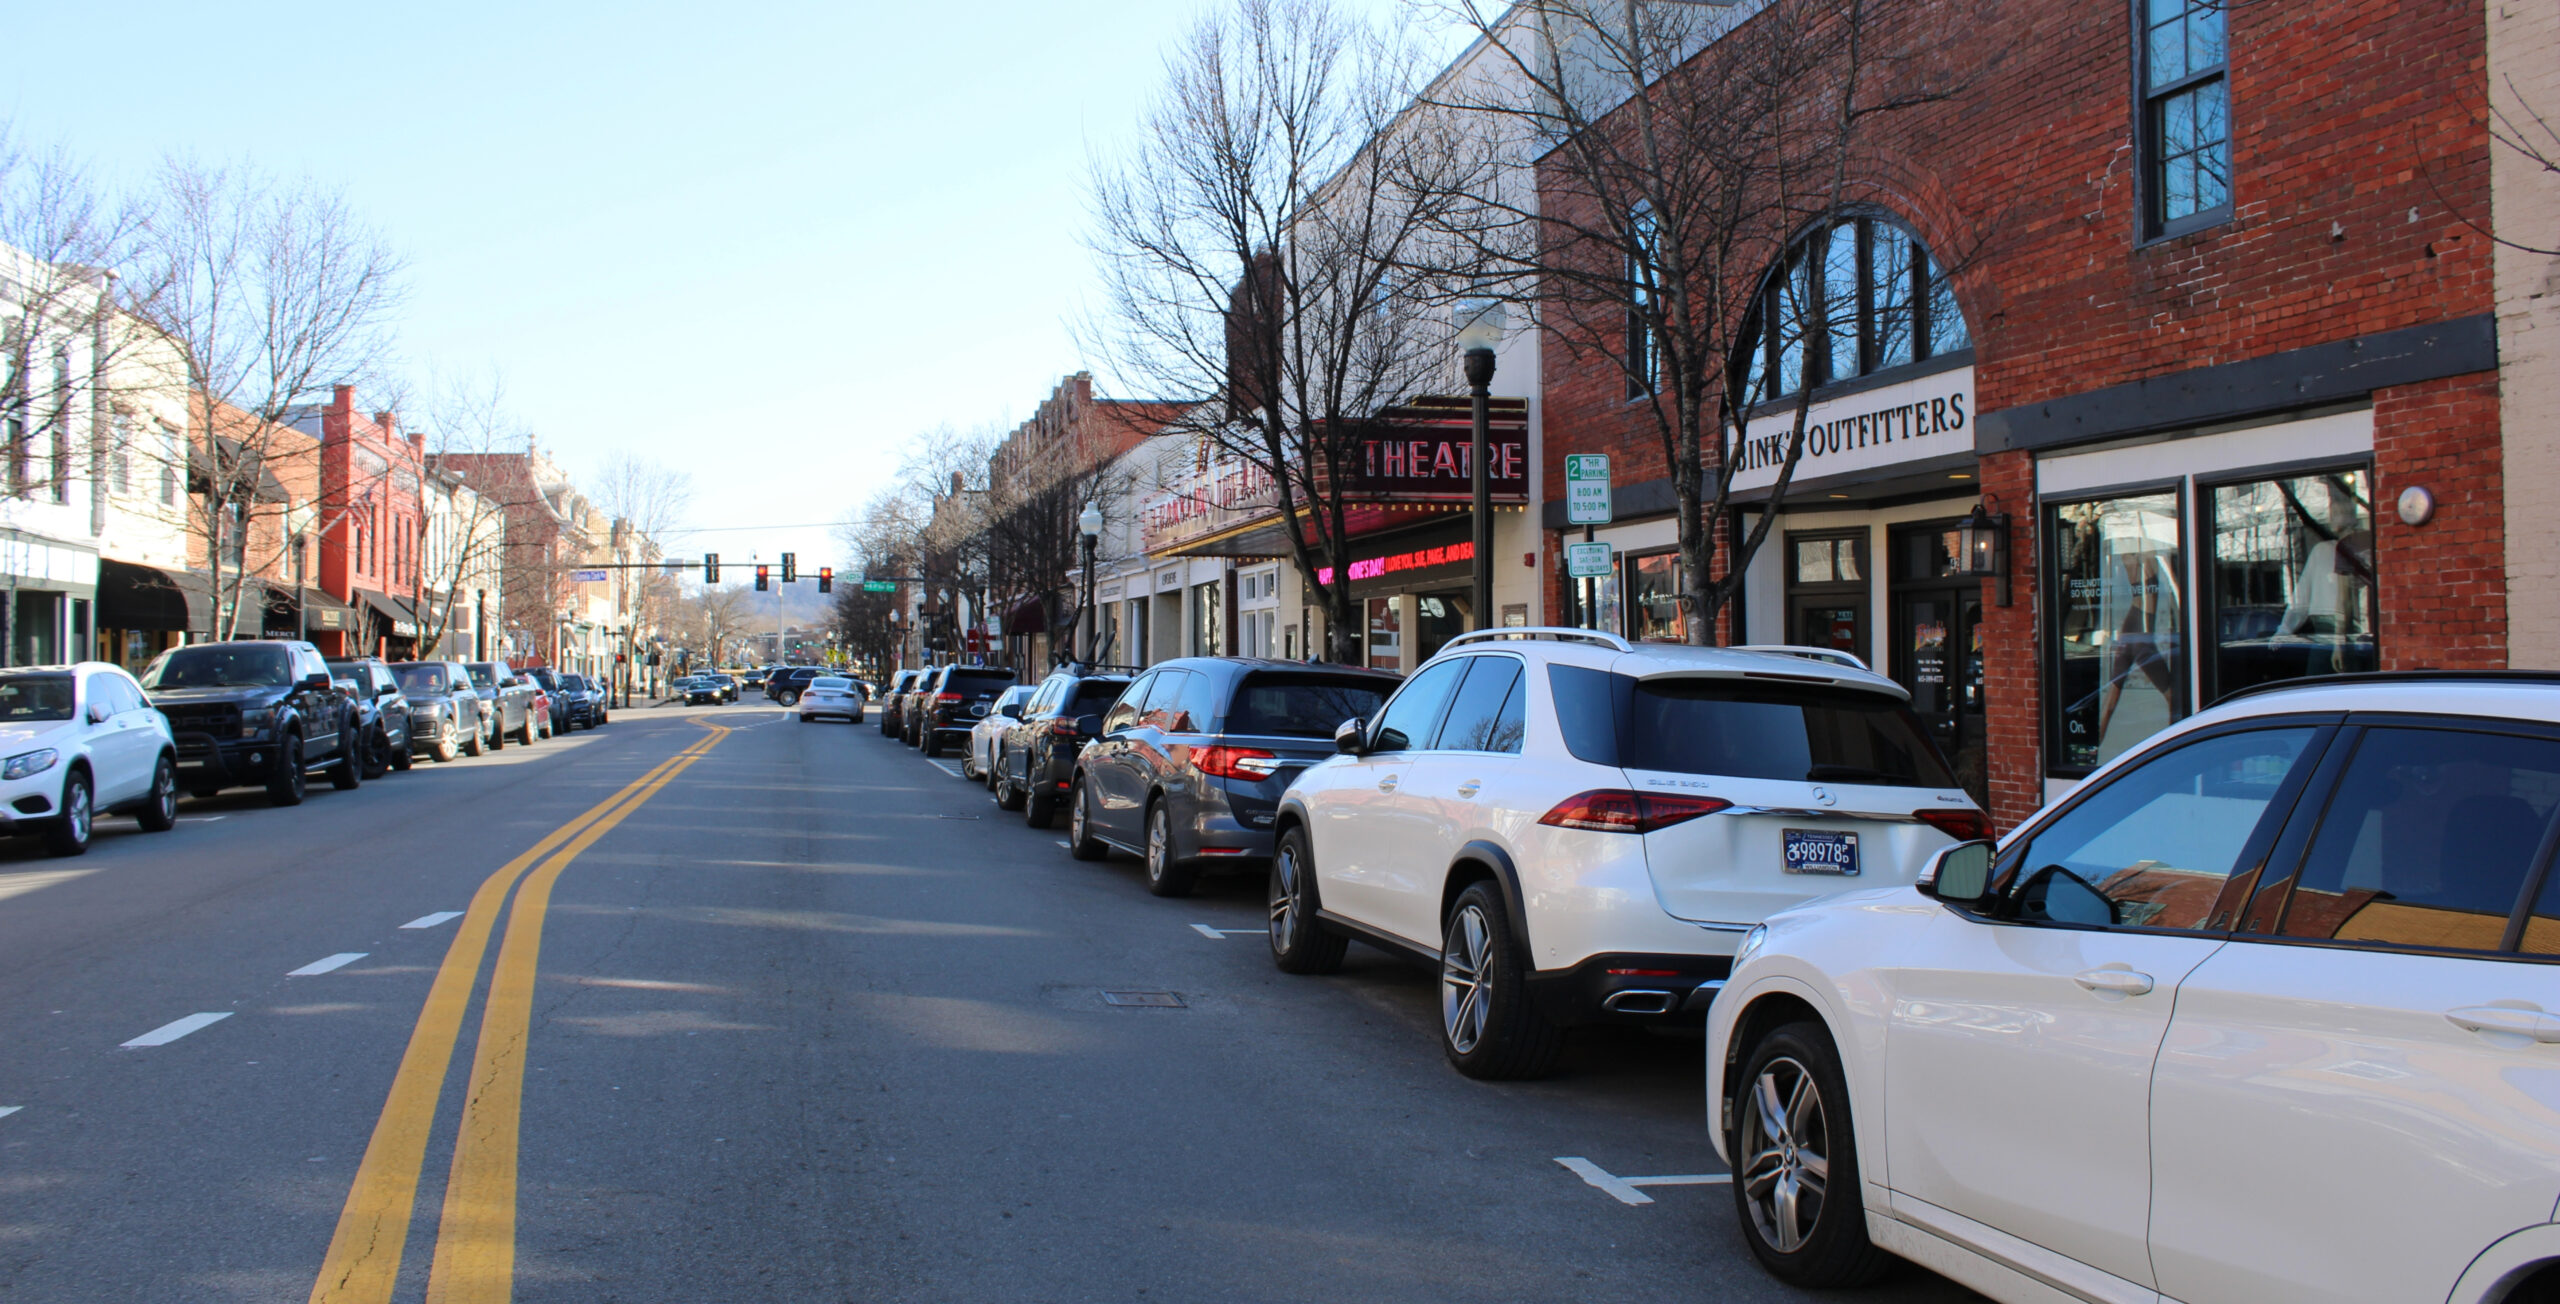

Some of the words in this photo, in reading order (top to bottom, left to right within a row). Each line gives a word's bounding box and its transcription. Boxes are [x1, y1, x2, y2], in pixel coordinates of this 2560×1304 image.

[1736, 431, 1803, 472] INK'
[1809, 393, 1965, 457] OUTFITTERS
[1362, 440, 1522, 479] THEATRE
[1569, 460, 1579, 477] 2
[1588, 458, 1600, 467] HR
[1581, 469, 1607, 478] PARKING
[1593, 487, 1602, 496] AM
[1573, 502, 1581, 511] TO
[1582, 502, 1596, 511] 5:00
[1598, 502, 1607, 511] PM
[1800, 842, 1842, 863] 98978
